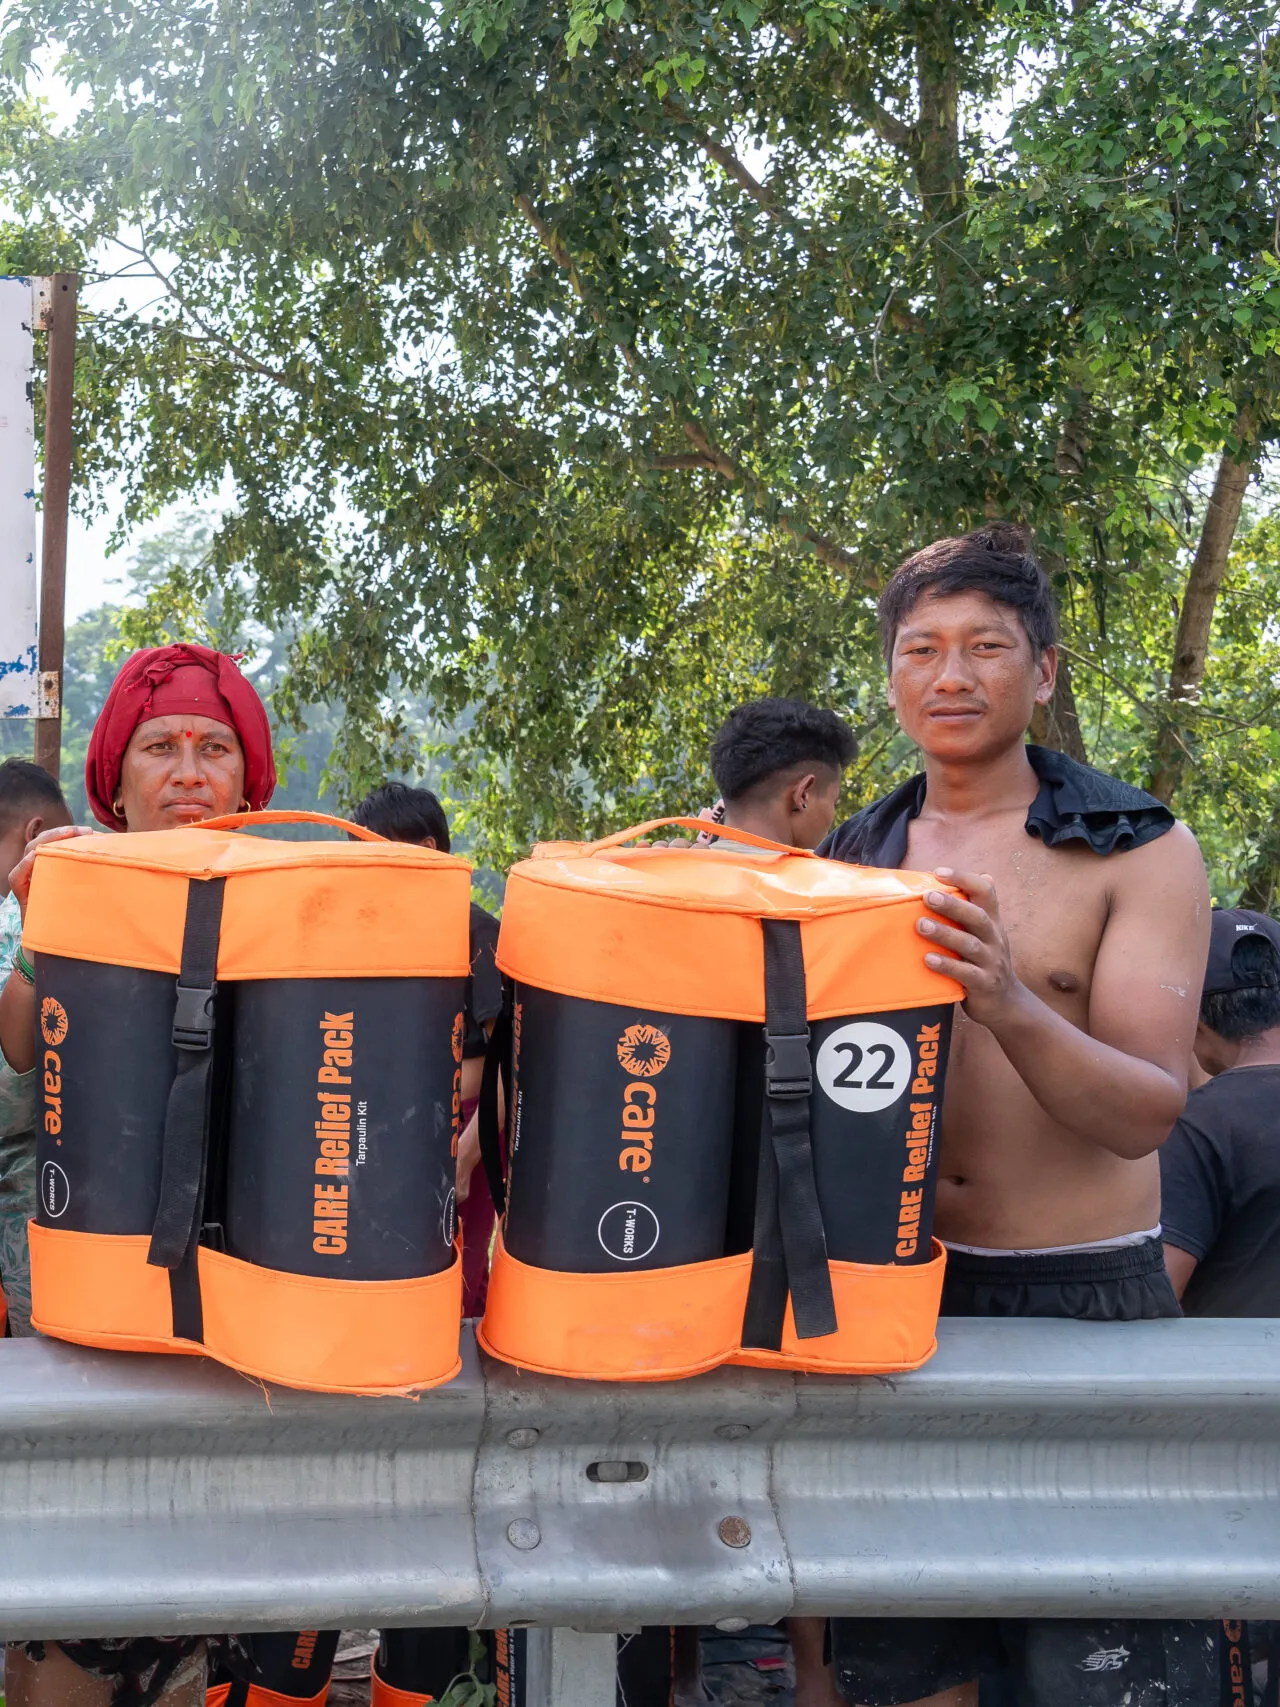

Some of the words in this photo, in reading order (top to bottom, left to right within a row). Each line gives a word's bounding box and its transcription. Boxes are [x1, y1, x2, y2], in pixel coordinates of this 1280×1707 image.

[317, 1011, 355, 1085] Pack
[832, 1042, 897, 1090] 22
[910, 1023, 941, 1095] Pack
[43, 1049, 63, 1135] care
[356, 1100, 369, 1116] Kit
[618, 1081, 657, 1173] care
[314, 1092, 353, 1176] Relief
[355, 1118, 370, 1168] Tarpaulin
[902, 1102, 934, 1183] Relief
[48, 1167, 56, 1212] T-WORKS
[312, 1184, 350, 1256] CARE
[895, 1187, 924, 1257] CARE
[622, 1208, 637, 1254] T-WORKS
